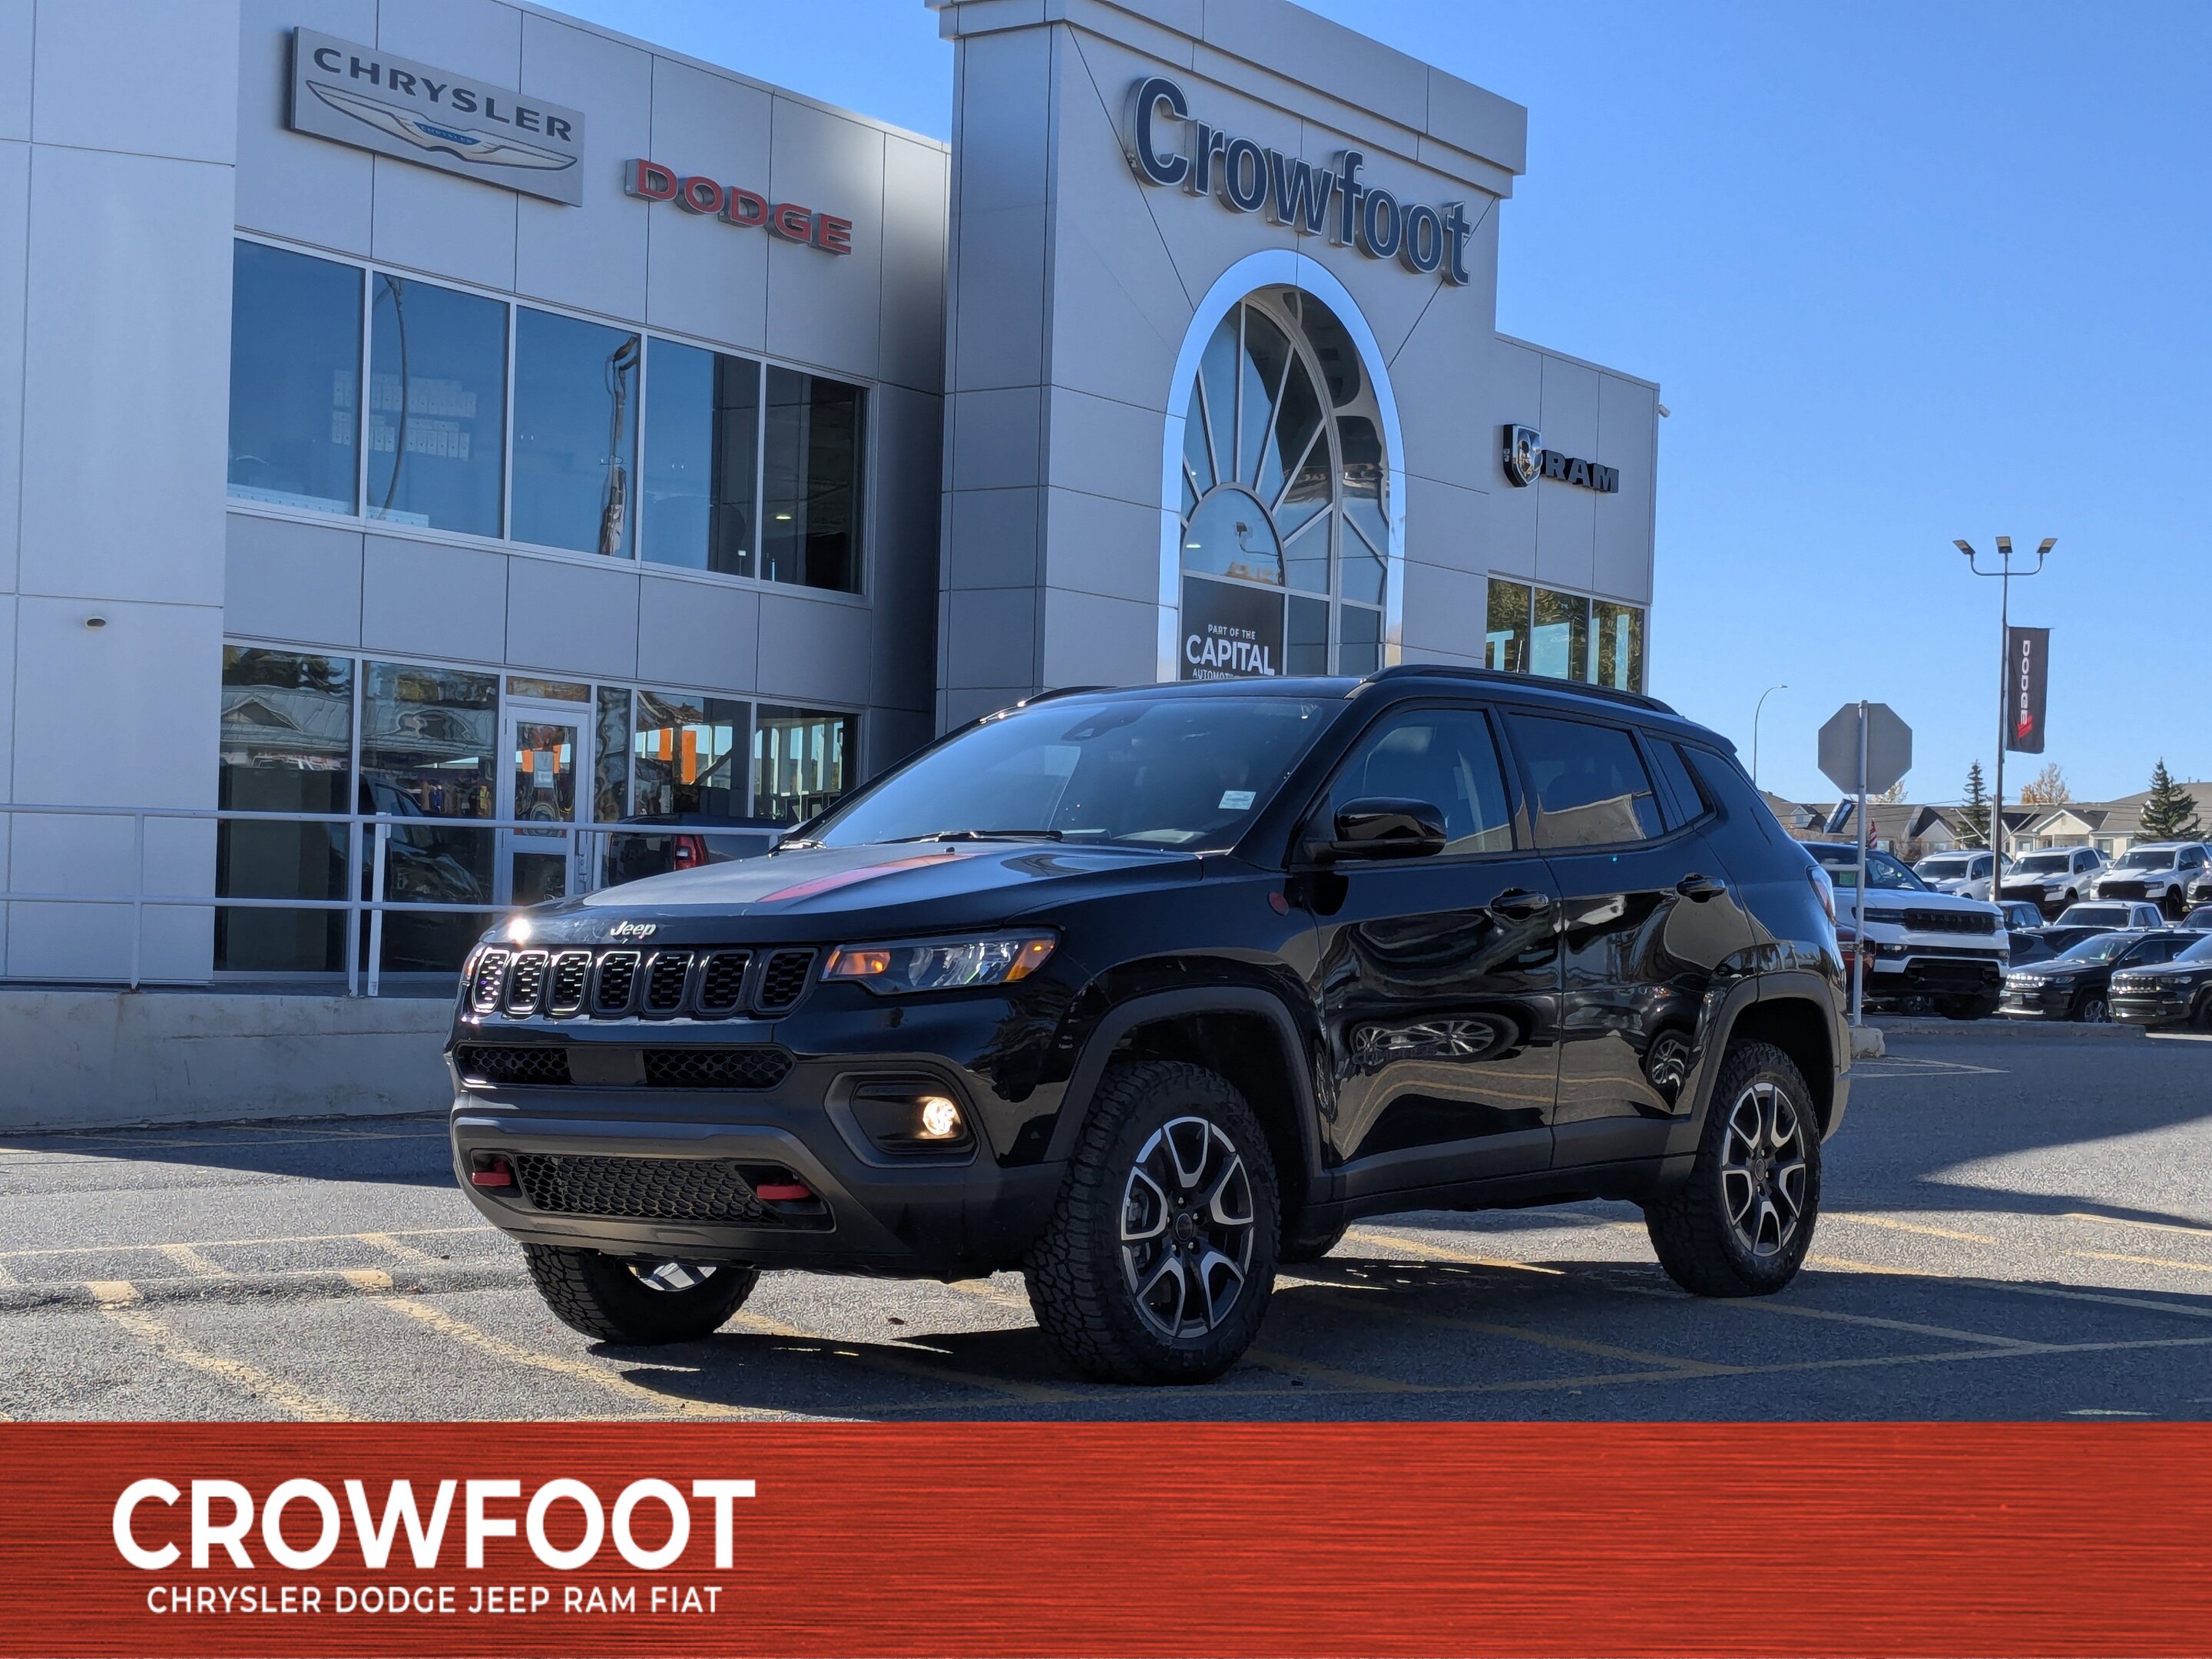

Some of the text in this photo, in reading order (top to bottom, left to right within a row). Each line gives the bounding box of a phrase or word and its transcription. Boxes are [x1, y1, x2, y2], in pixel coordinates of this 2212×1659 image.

[313, 47, 573, 143] CHRYSLER
[627, 158, 853, 256] DODGE
[1127, 75, 1472, 287] Crowfoot
[1542, 449, 1619, 494] RAM
[1185, 634, 1276, 677] CAPITAL
[1207, 624, 1256, 640] PART OF THE
[2021, 640, 2031, 725] DODGE
[610, 920, 657, 939] Jeep
